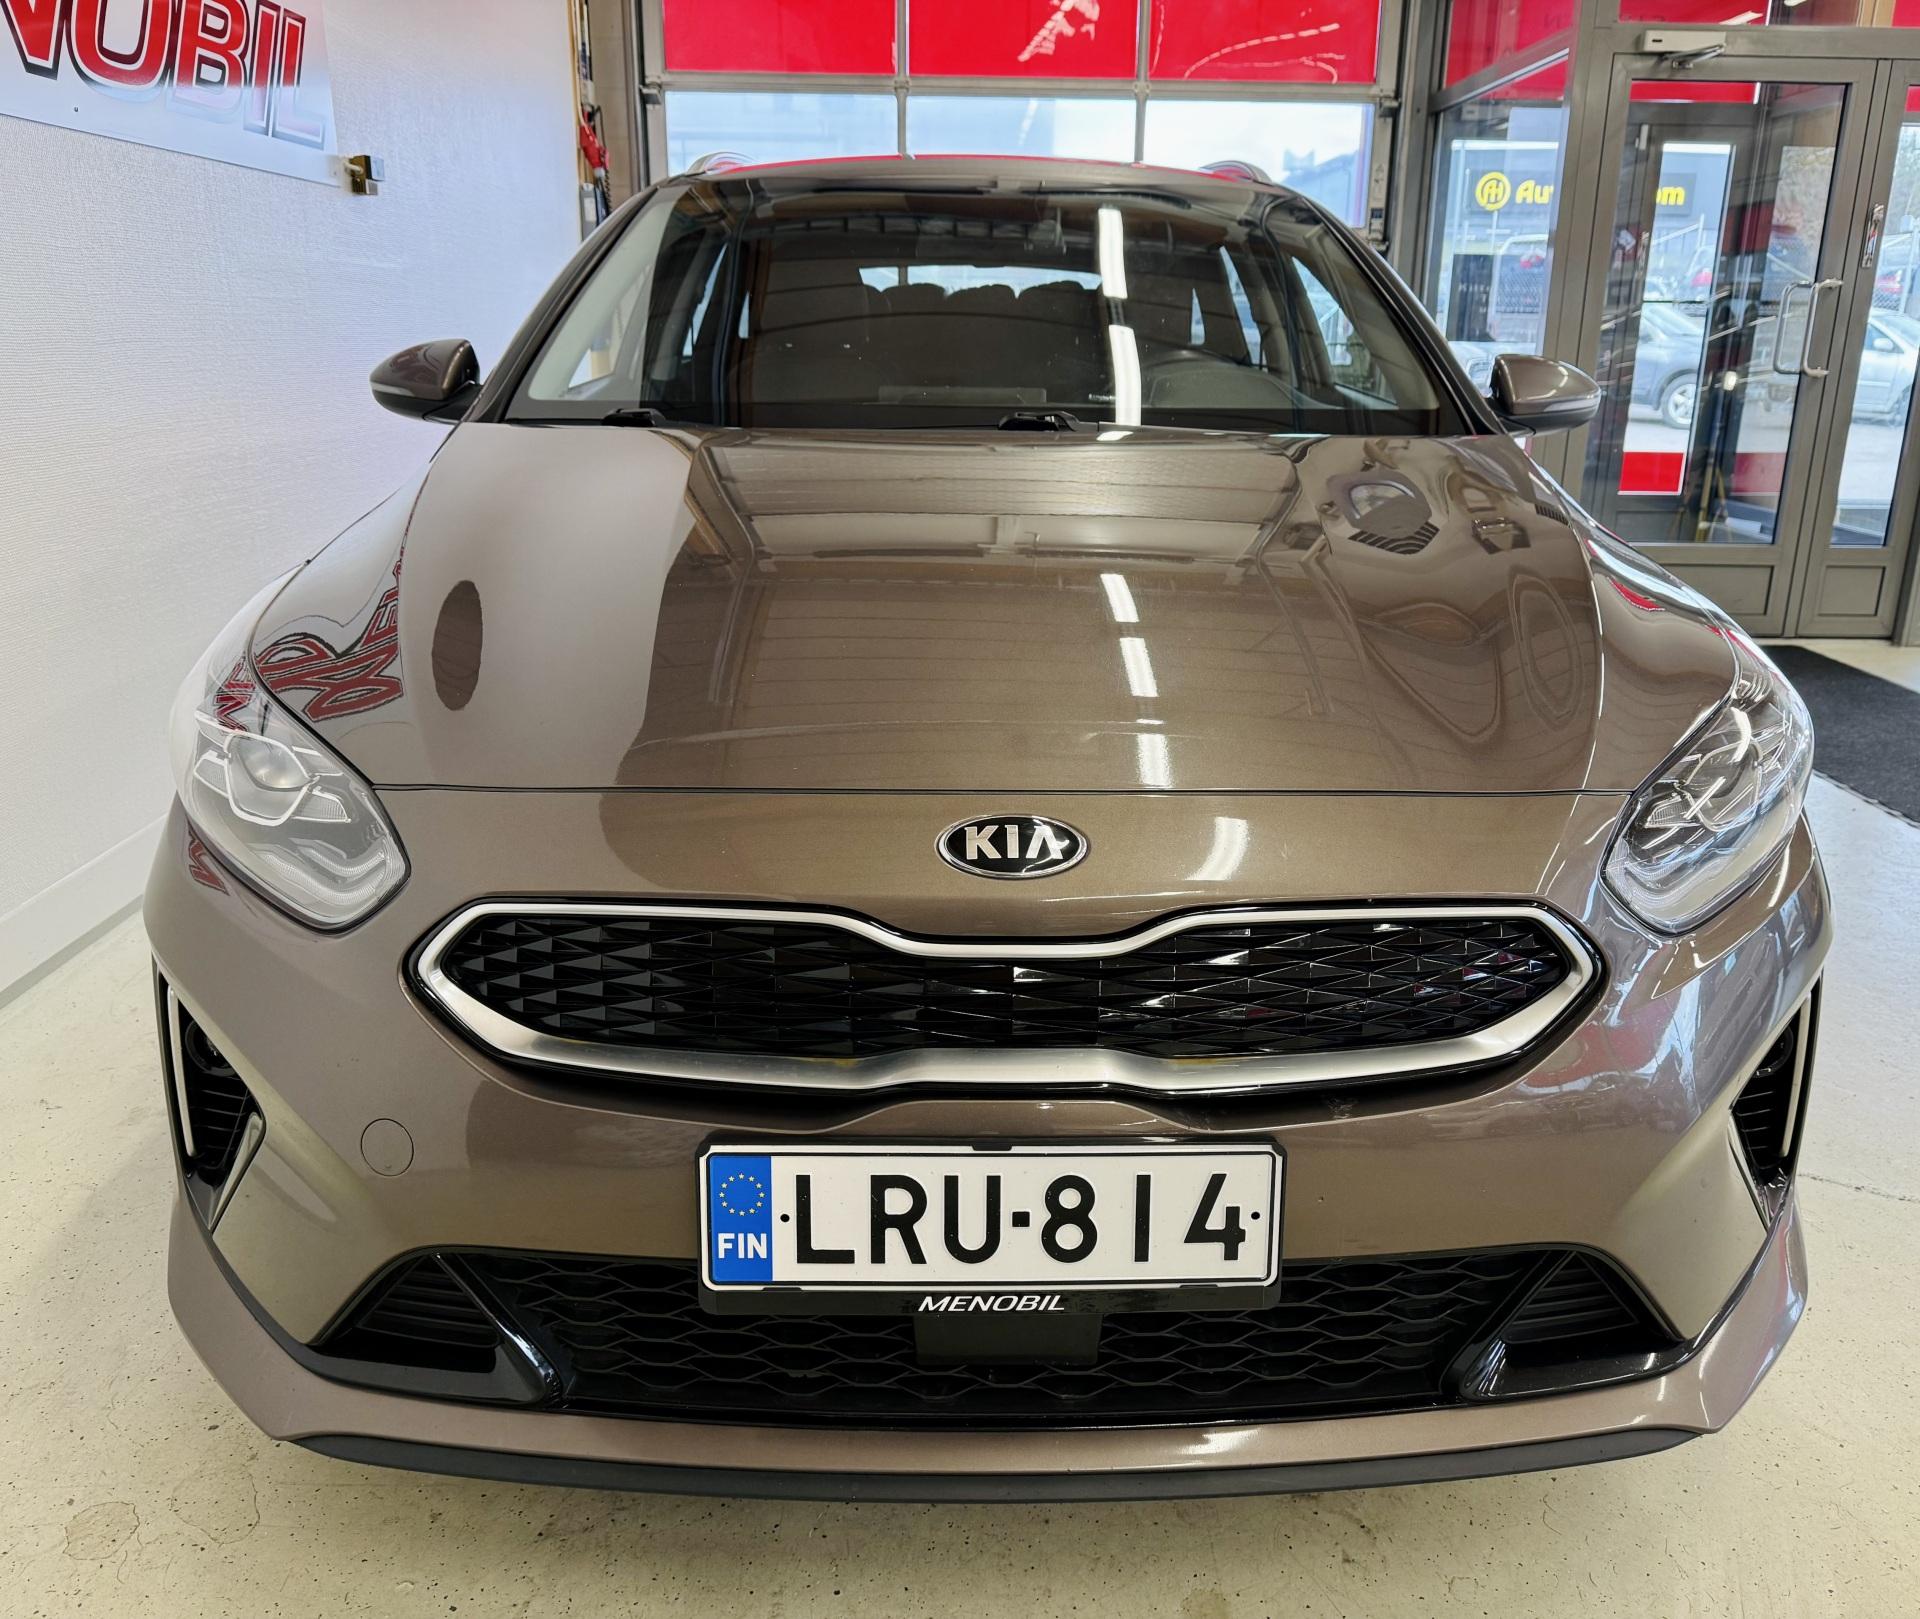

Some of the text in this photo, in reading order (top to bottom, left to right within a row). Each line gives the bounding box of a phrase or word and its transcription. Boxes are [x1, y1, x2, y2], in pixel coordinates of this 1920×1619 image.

[964, 824, 1064, 860] KIA
[795, 1173, 1247, 1265] LRU-814
[717, 1232, 768, 1260] FIN
[917, 1294, 1065, 1312] MENOBIL
